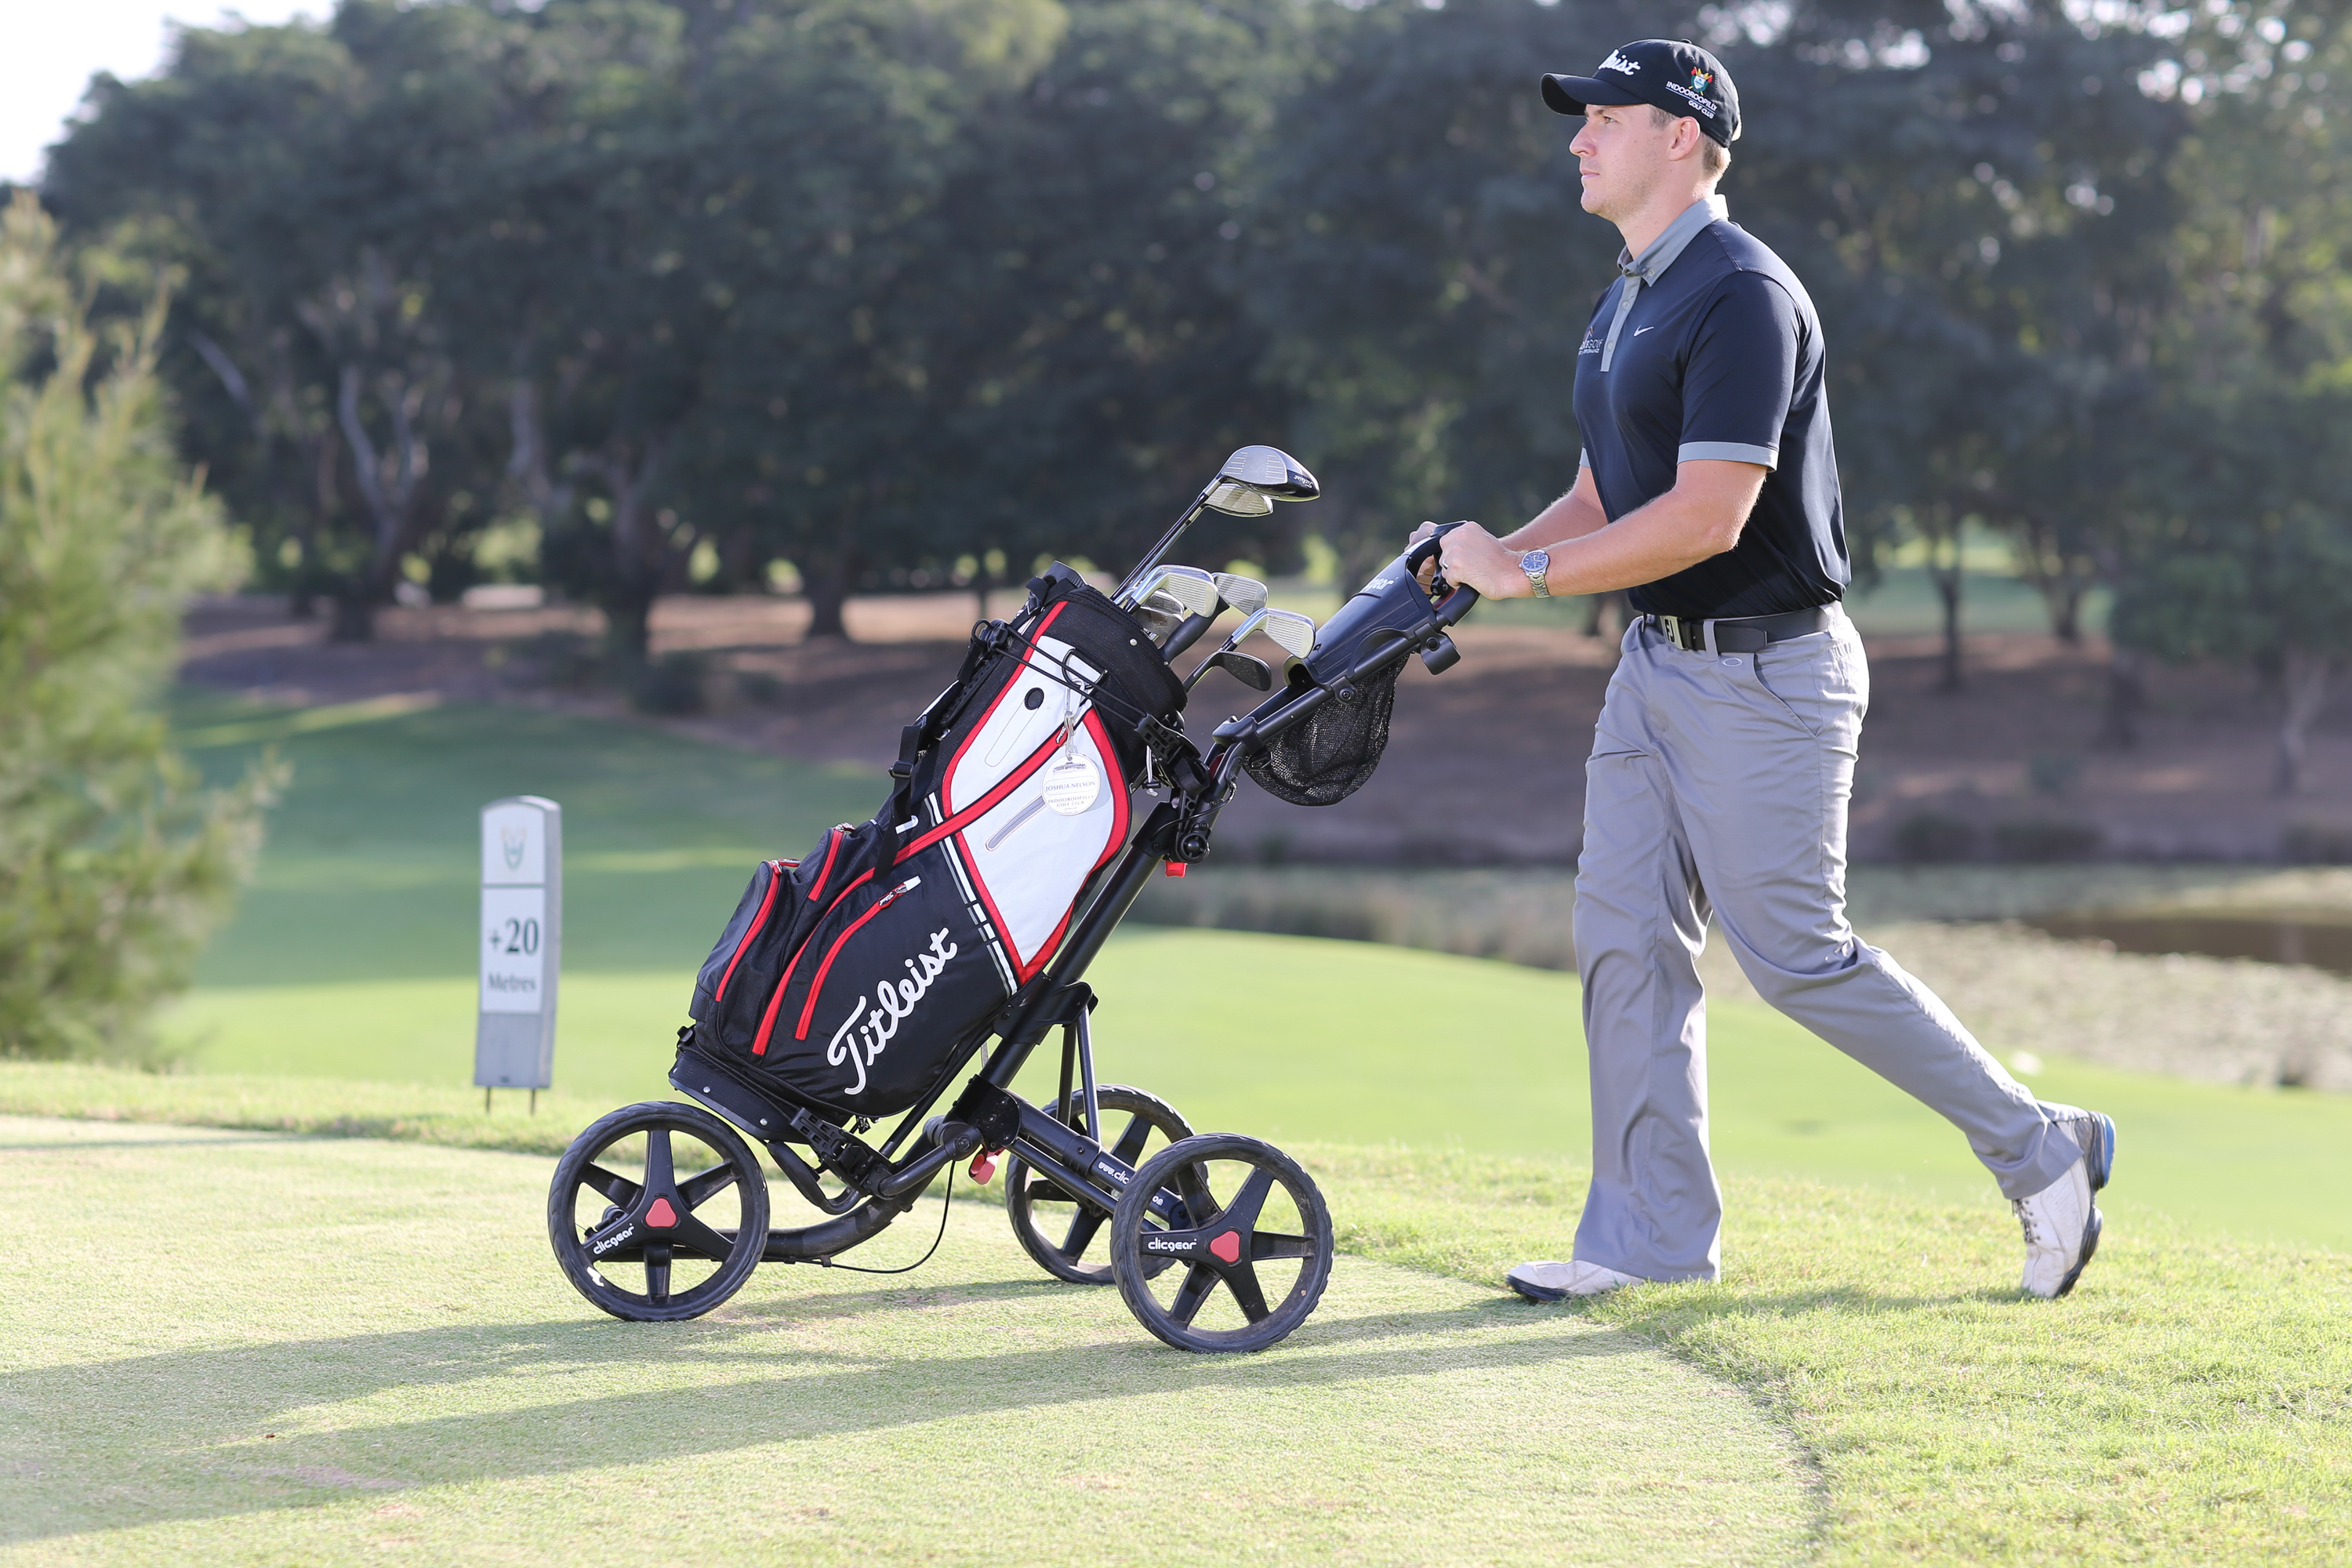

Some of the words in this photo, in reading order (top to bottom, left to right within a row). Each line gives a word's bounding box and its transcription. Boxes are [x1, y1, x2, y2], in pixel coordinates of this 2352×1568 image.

[1598, 49, 1641, 75] leist
[1666, 81, 1718, 111] INDOOROOPILLY
[1688, 100, 1703, 111] GOLF
[1701, 108, 1715, 119] CLUB
[489, 917, 539, 956] +20
[488, 972, 536, 993] Metres
[826, 927, 958, 1095] Titleist
[593, 1225, 635, 1254] clicgear
[1147, 1236, 1197, 1252] clicgear
